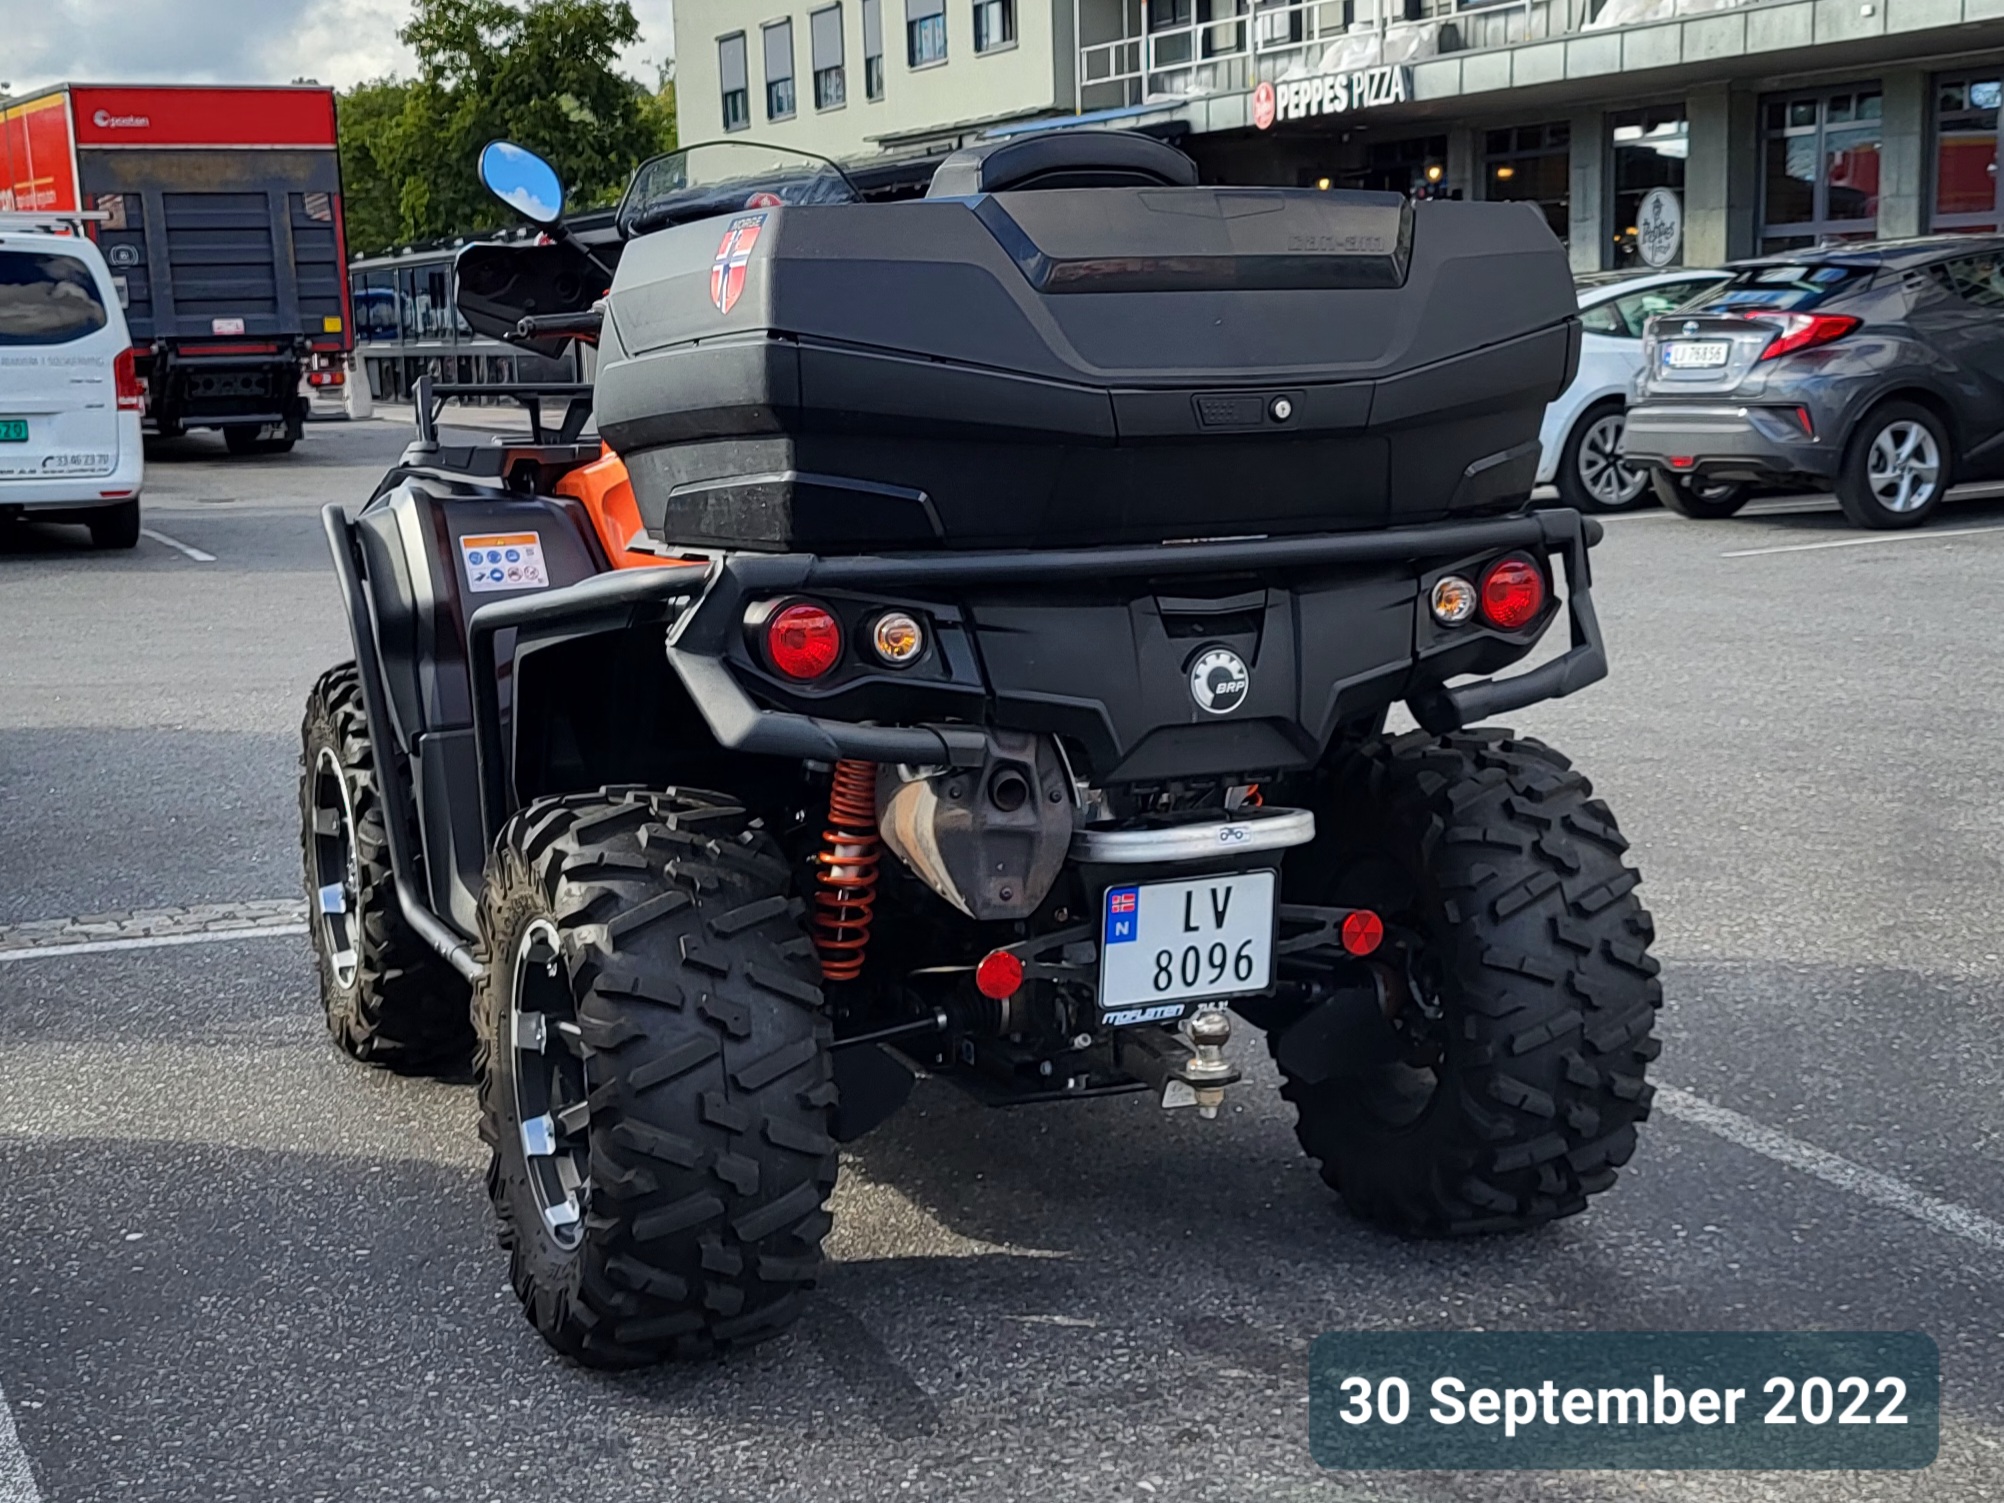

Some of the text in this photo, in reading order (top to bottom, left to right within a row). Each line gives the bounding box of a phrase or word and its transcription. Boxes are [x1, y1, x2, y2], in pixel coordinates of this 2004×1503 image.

[1276, 74, 1348, 121] PEPPES
[1352, 64, 1405, 110] PIZZA
[1216, 681, 1245, 694] BRP
[1115, 886, 1232, 936] N LV
[1153, 939, 1253, 992] 8096
